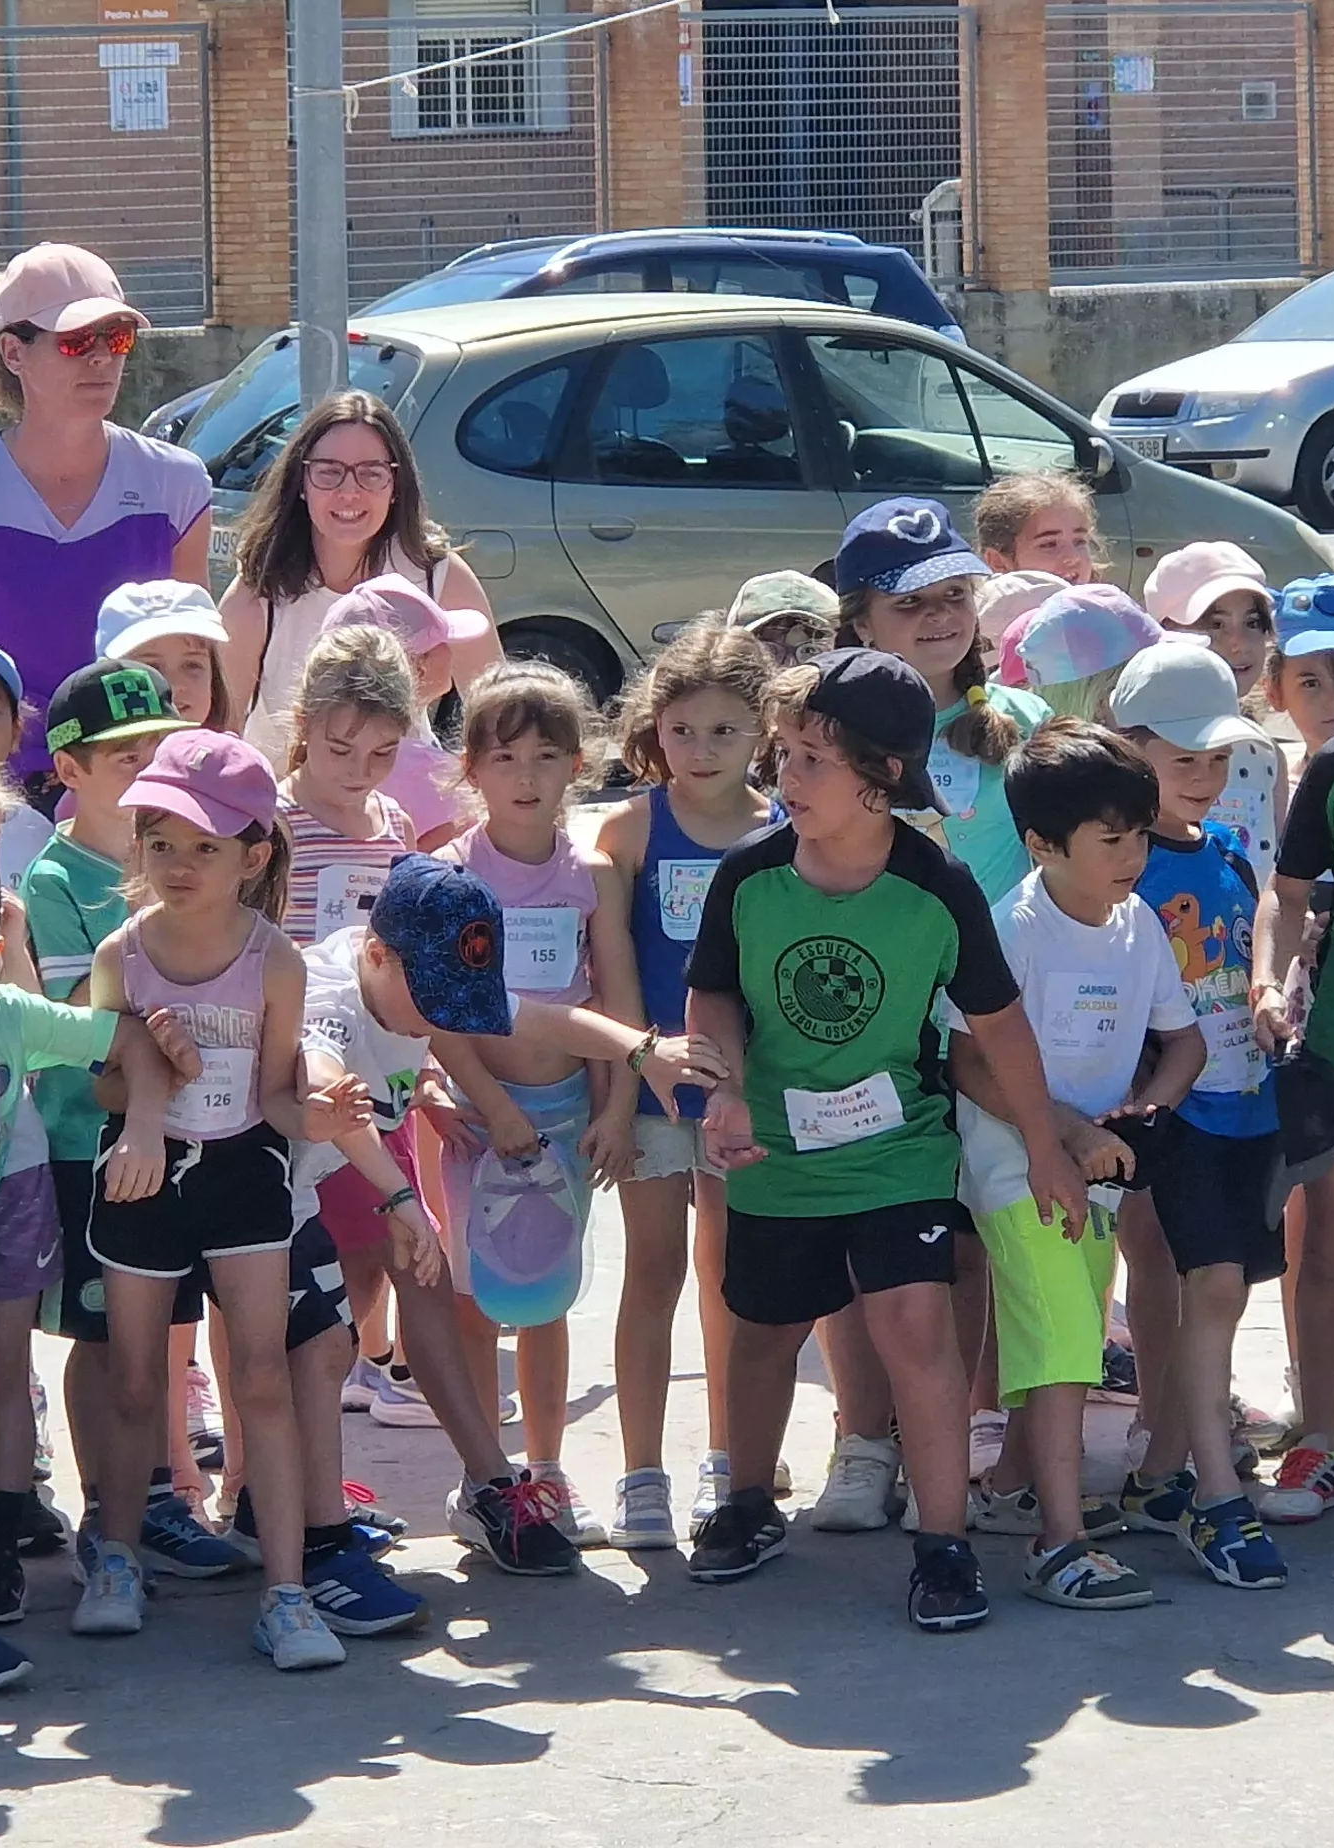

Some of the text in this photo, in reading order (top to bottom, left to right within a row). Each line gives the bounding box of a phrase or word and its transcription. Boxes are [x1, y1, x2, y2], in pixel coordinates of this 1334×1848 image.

[104, 9, 131, 19] Pedro
[142, 9, 169, 18] Rubio
[530, 949, 557, 962] 155
[797, 942, 863, 966] ESCUELA
[1096, 1019, 1117, 1033] 474
[203, 1093, 232, 1108] 126
